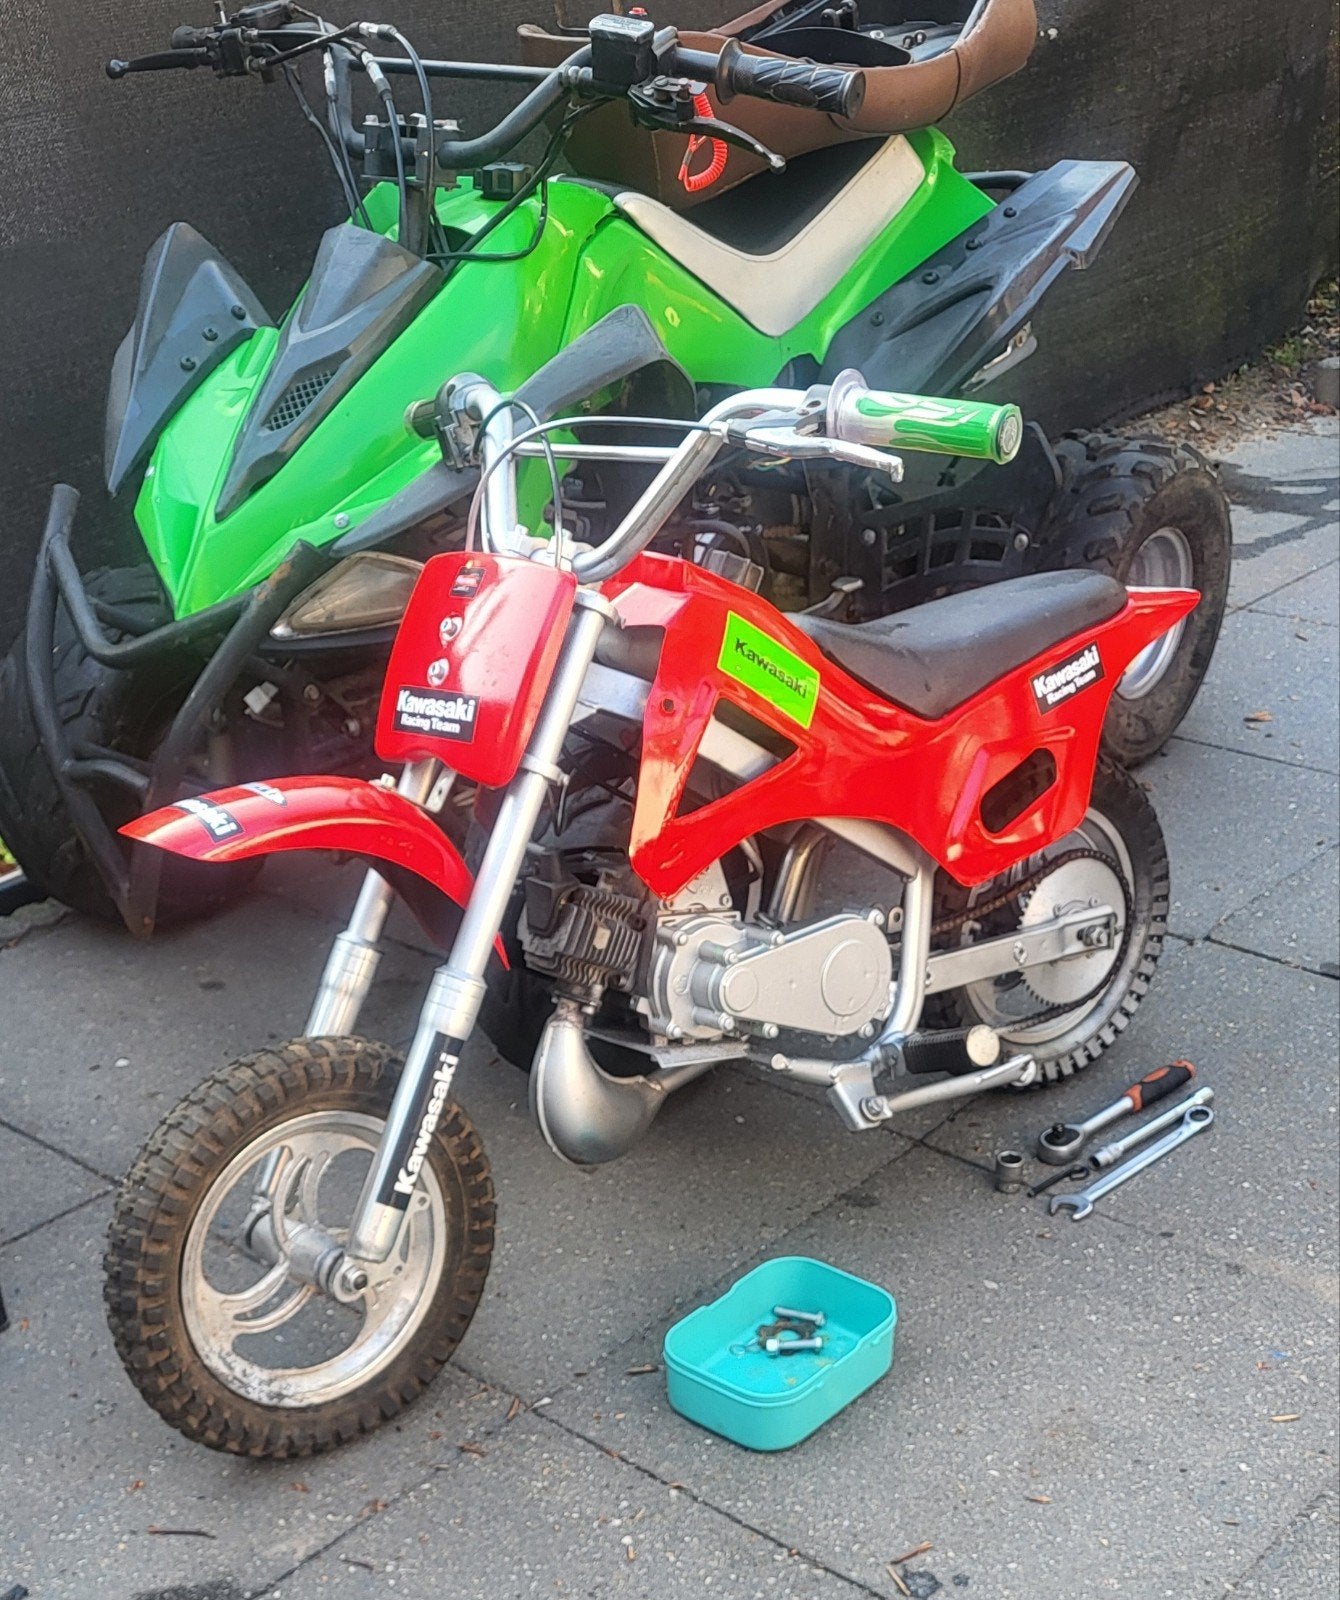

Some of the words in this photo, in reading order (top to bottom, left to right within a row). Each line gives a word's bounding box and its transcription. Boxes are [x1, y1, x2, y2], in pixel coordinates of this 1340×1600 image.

[734, 637, 808, 699] Kawasaki
[1033, 645, 1100, 698] Kawasaki
[396, 689, 476, 722] Kawasaki
[400, 712, 431, 732] Racing
[431, 717, 461, 734] Team
[394, 1052, 459, 1195] Kawasaki
